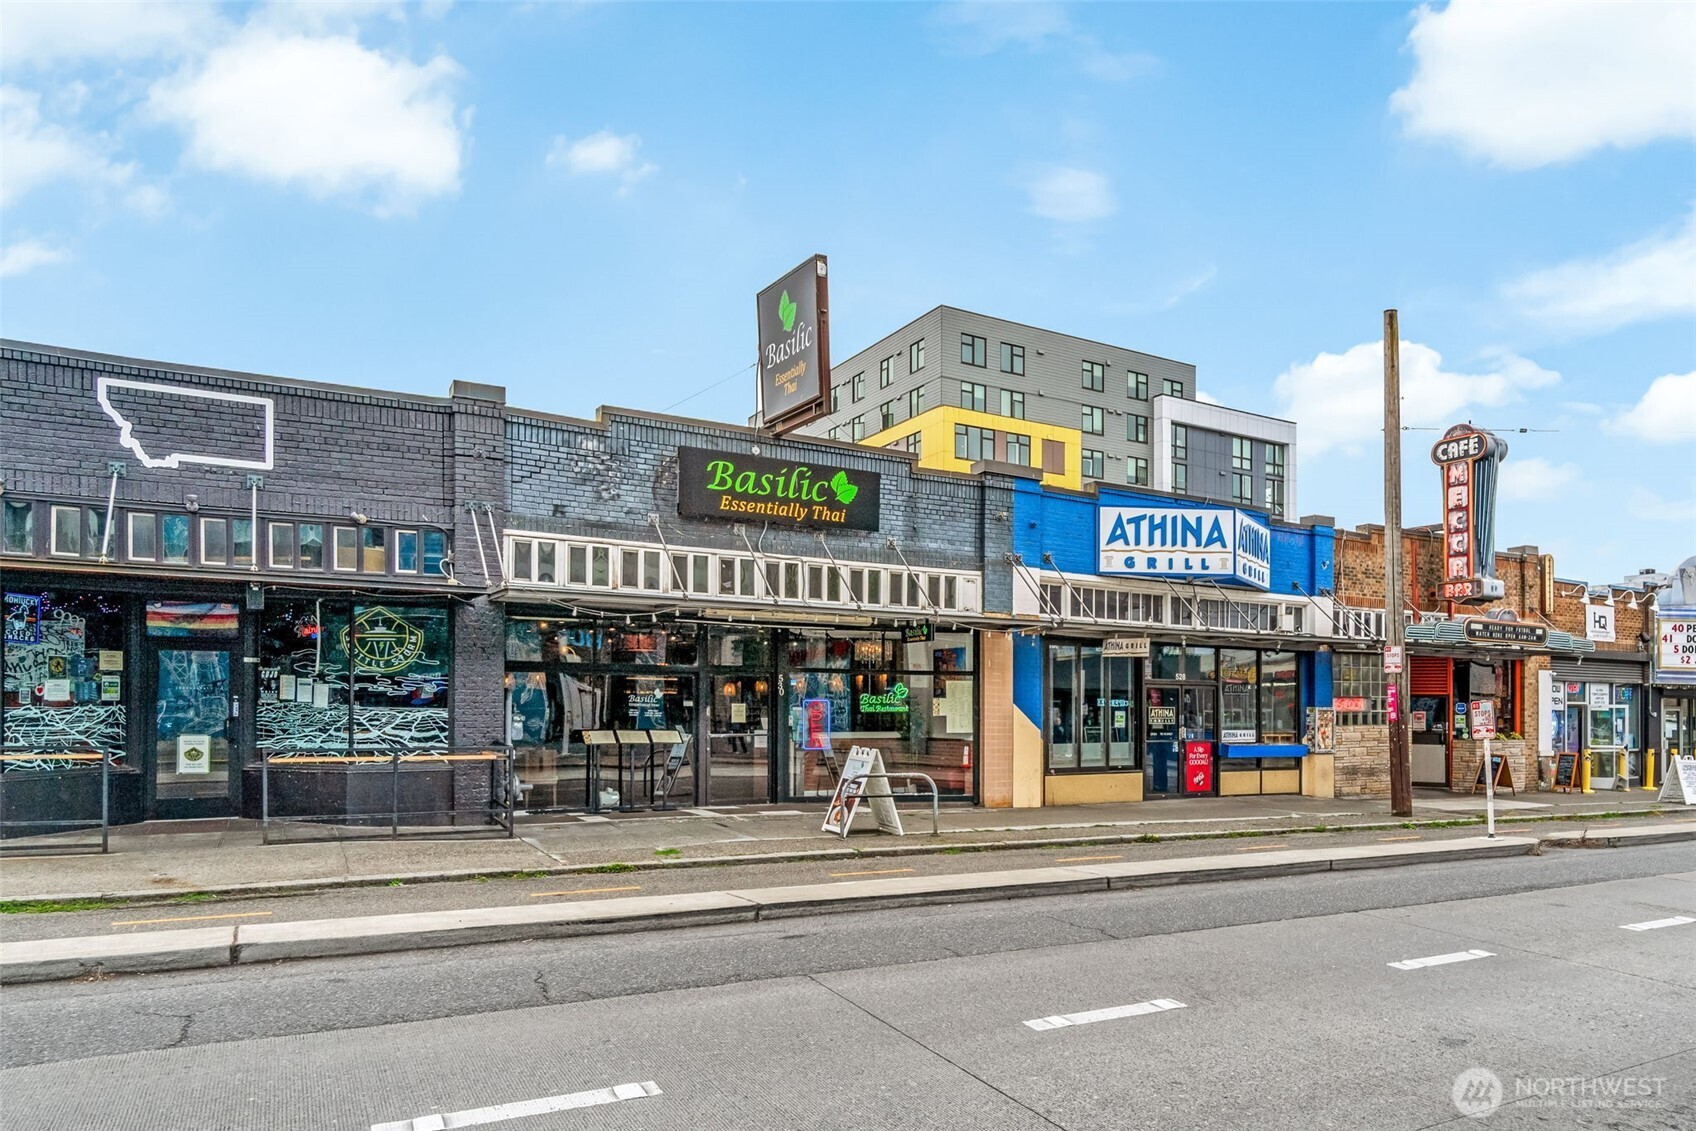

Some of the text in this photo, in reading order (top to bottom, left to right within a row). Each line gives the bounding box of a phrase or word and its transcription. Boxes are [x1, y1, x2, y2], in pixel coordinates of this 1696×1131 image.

[765, 321, 813, 370] Basilic
[775, 361, 807, 387] Essentially
[784, 379, 798, 396] Thai
[1436, 434, 1480, 461] CAFÉ
[706, 460, 829, 503] Basilic
[720, 495, 847, 523] Essentially Thai
[1448, 462, 1469, 581] MECCA
[1105, 511, 1228, 549] ATHINA
[1237, 517, 1270, 565] ATHINA
[1124, 556, 1210, 571] GRILL
[1242, 566, 1266, 583] GRILL
[1443, 583, 1473, 599] BAR
[1671, 624, 1684, 633] 40
[1104, 642, 1148, 651] ATHINA GRILL
[1662, 635, 1673, 643] 41
[1680, 656, 1691, 665] $2
[777, 674, 785, 696] 530
[1175, 673, 1186, 681] 528
[628, 694, 658, 703] Basilic
[860, 693, 900, 704] Basilic
[1552, 697, 1563, 705] PEN
[1150, 709, 1174, 718] ATHINA
